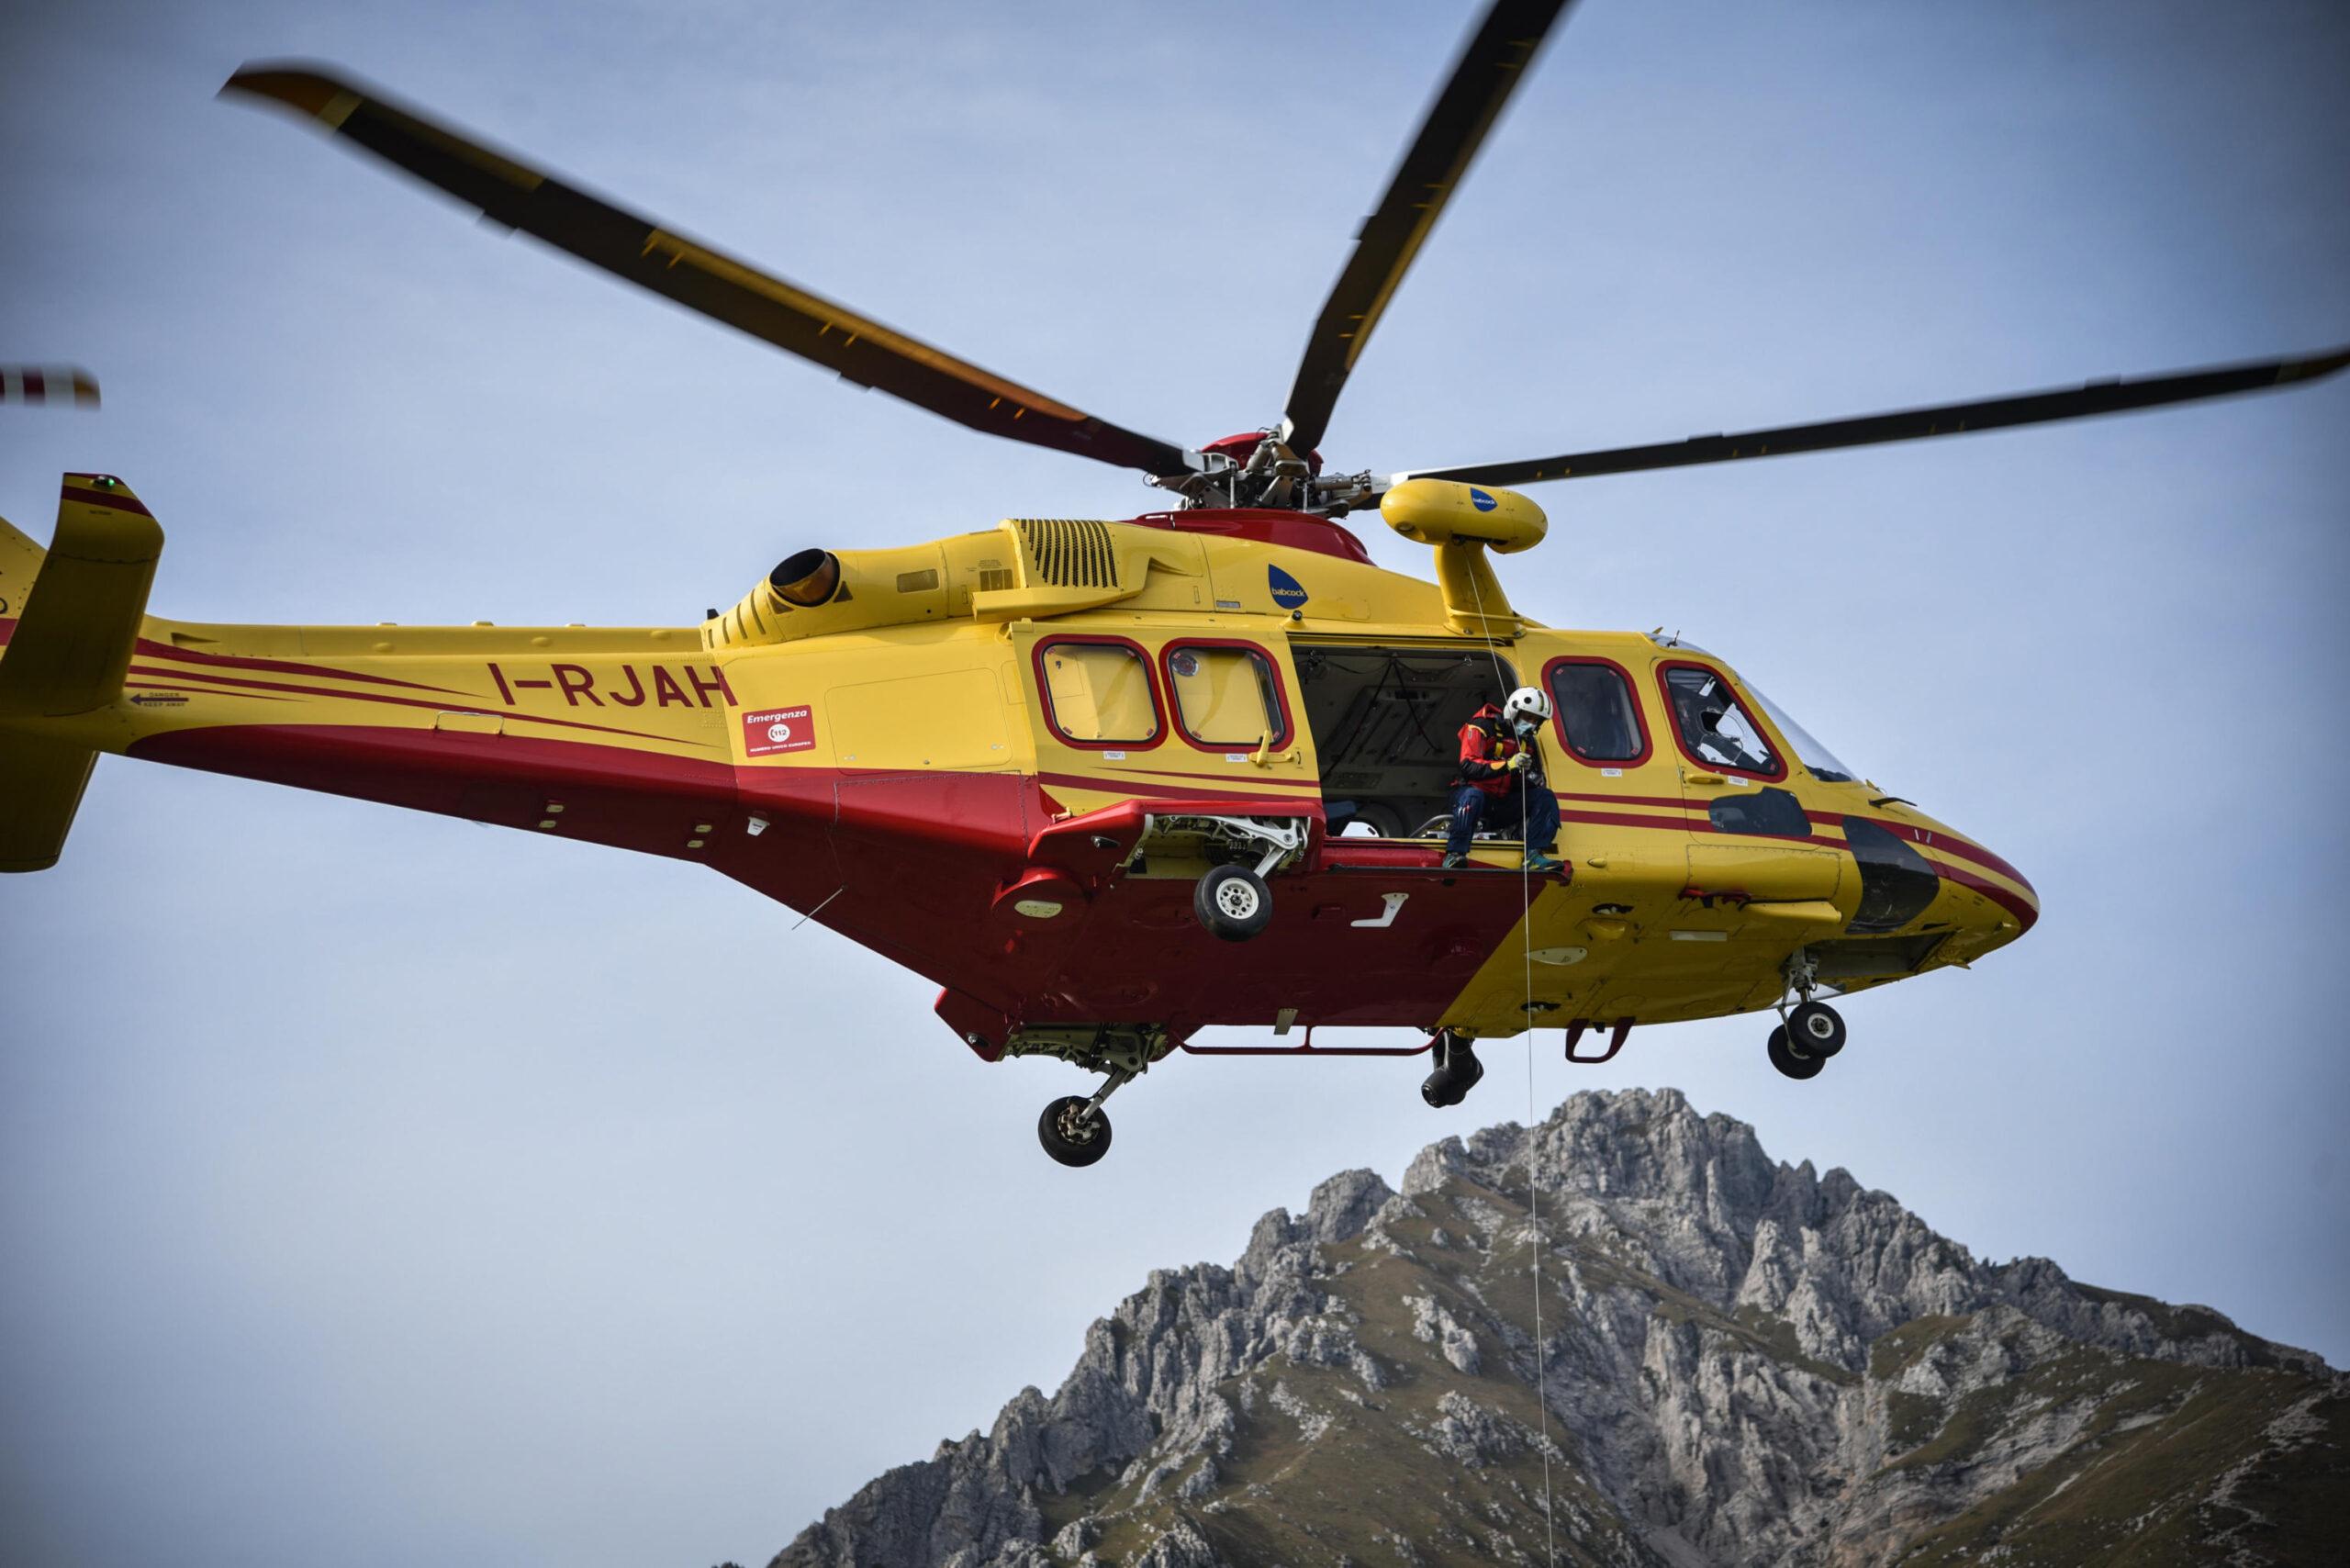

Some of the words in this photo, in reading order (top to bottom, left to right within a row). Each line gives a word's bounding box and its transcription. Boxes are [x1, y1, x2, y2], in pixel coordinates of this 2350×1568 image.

[1271, 587, 1304, 597] babcock
[487, 663, 738, 708] I-RJAH
[747, 711, 807, 723] Emergenza
